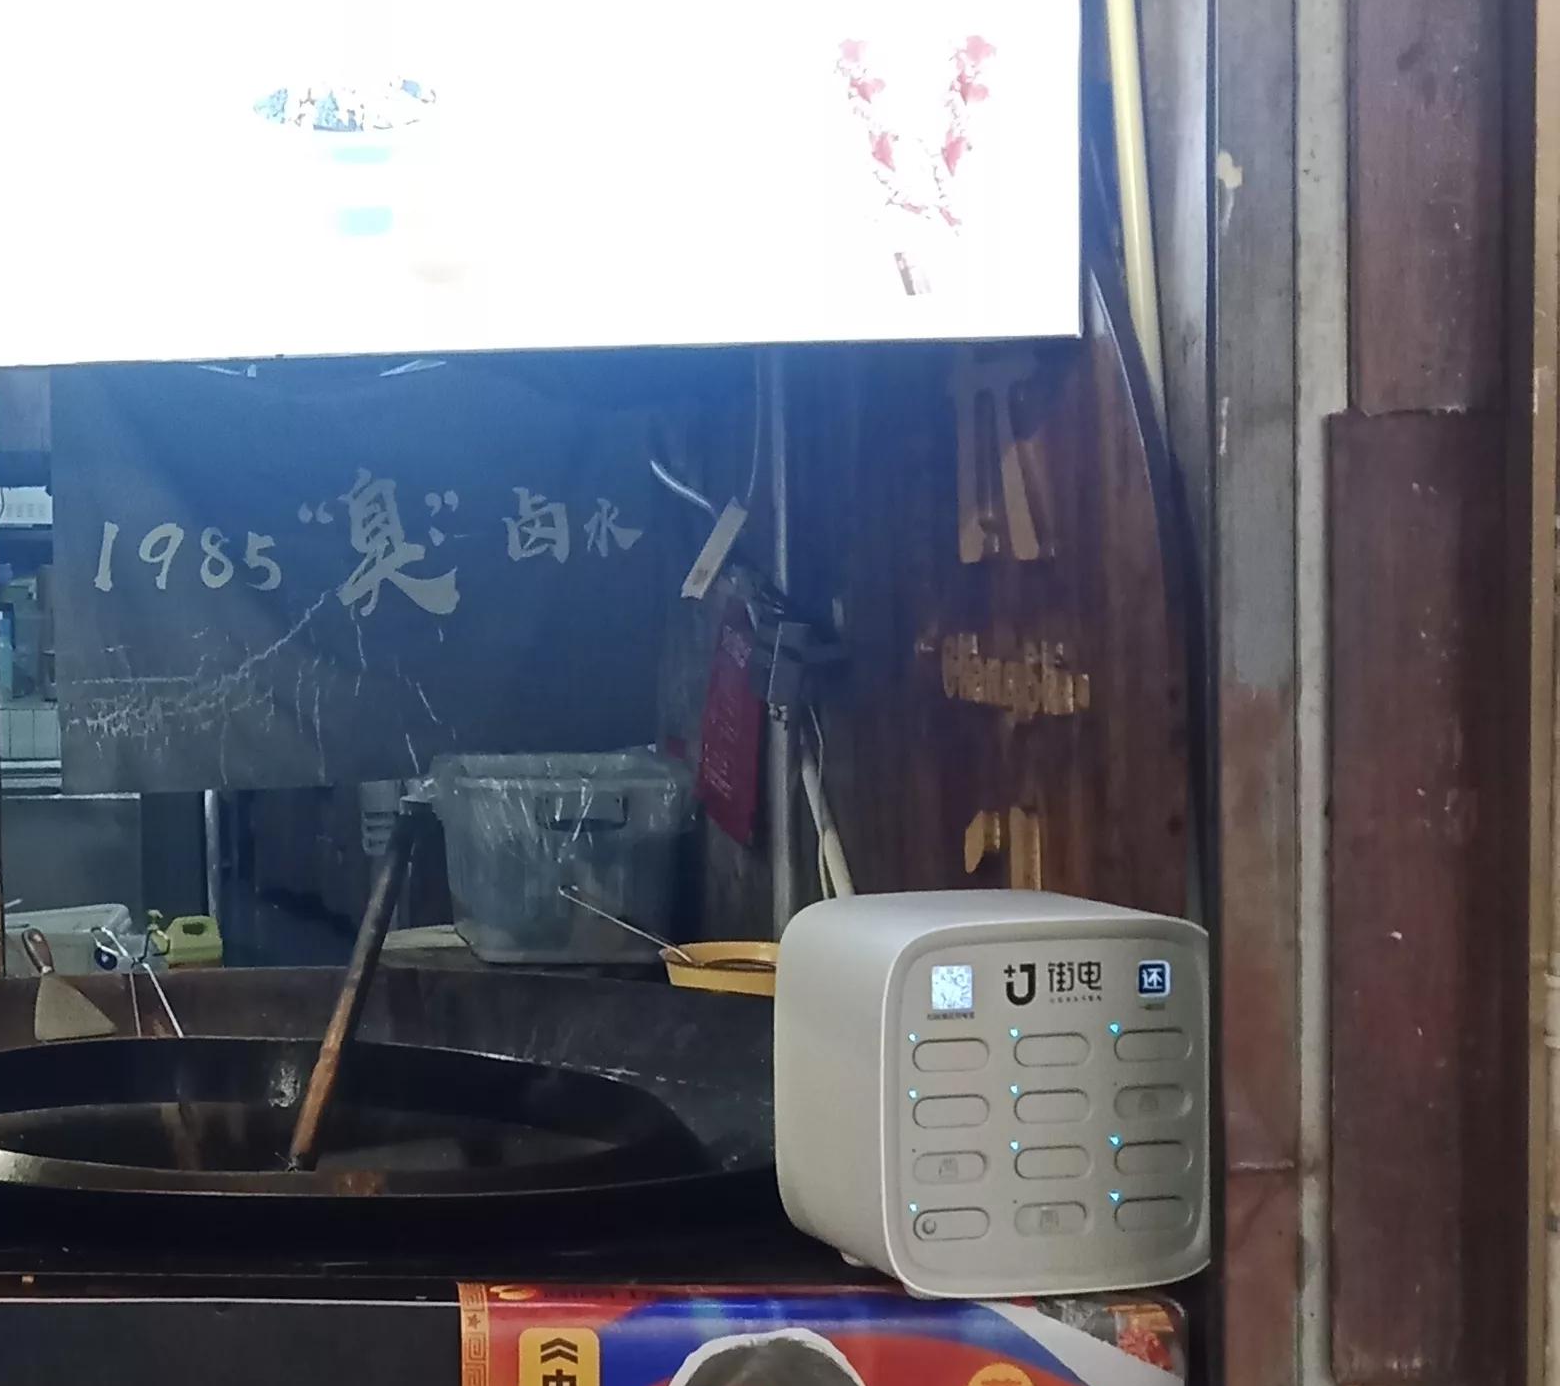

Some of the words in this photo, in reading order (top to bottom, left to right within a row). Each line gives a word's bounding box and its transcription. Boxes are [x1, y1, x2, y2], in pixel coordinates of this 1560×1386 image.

[94, 520, 283, 592] 1985
[503, 486, 643, 564] 卤水
[1047, 961, 1102, 992] 街电
